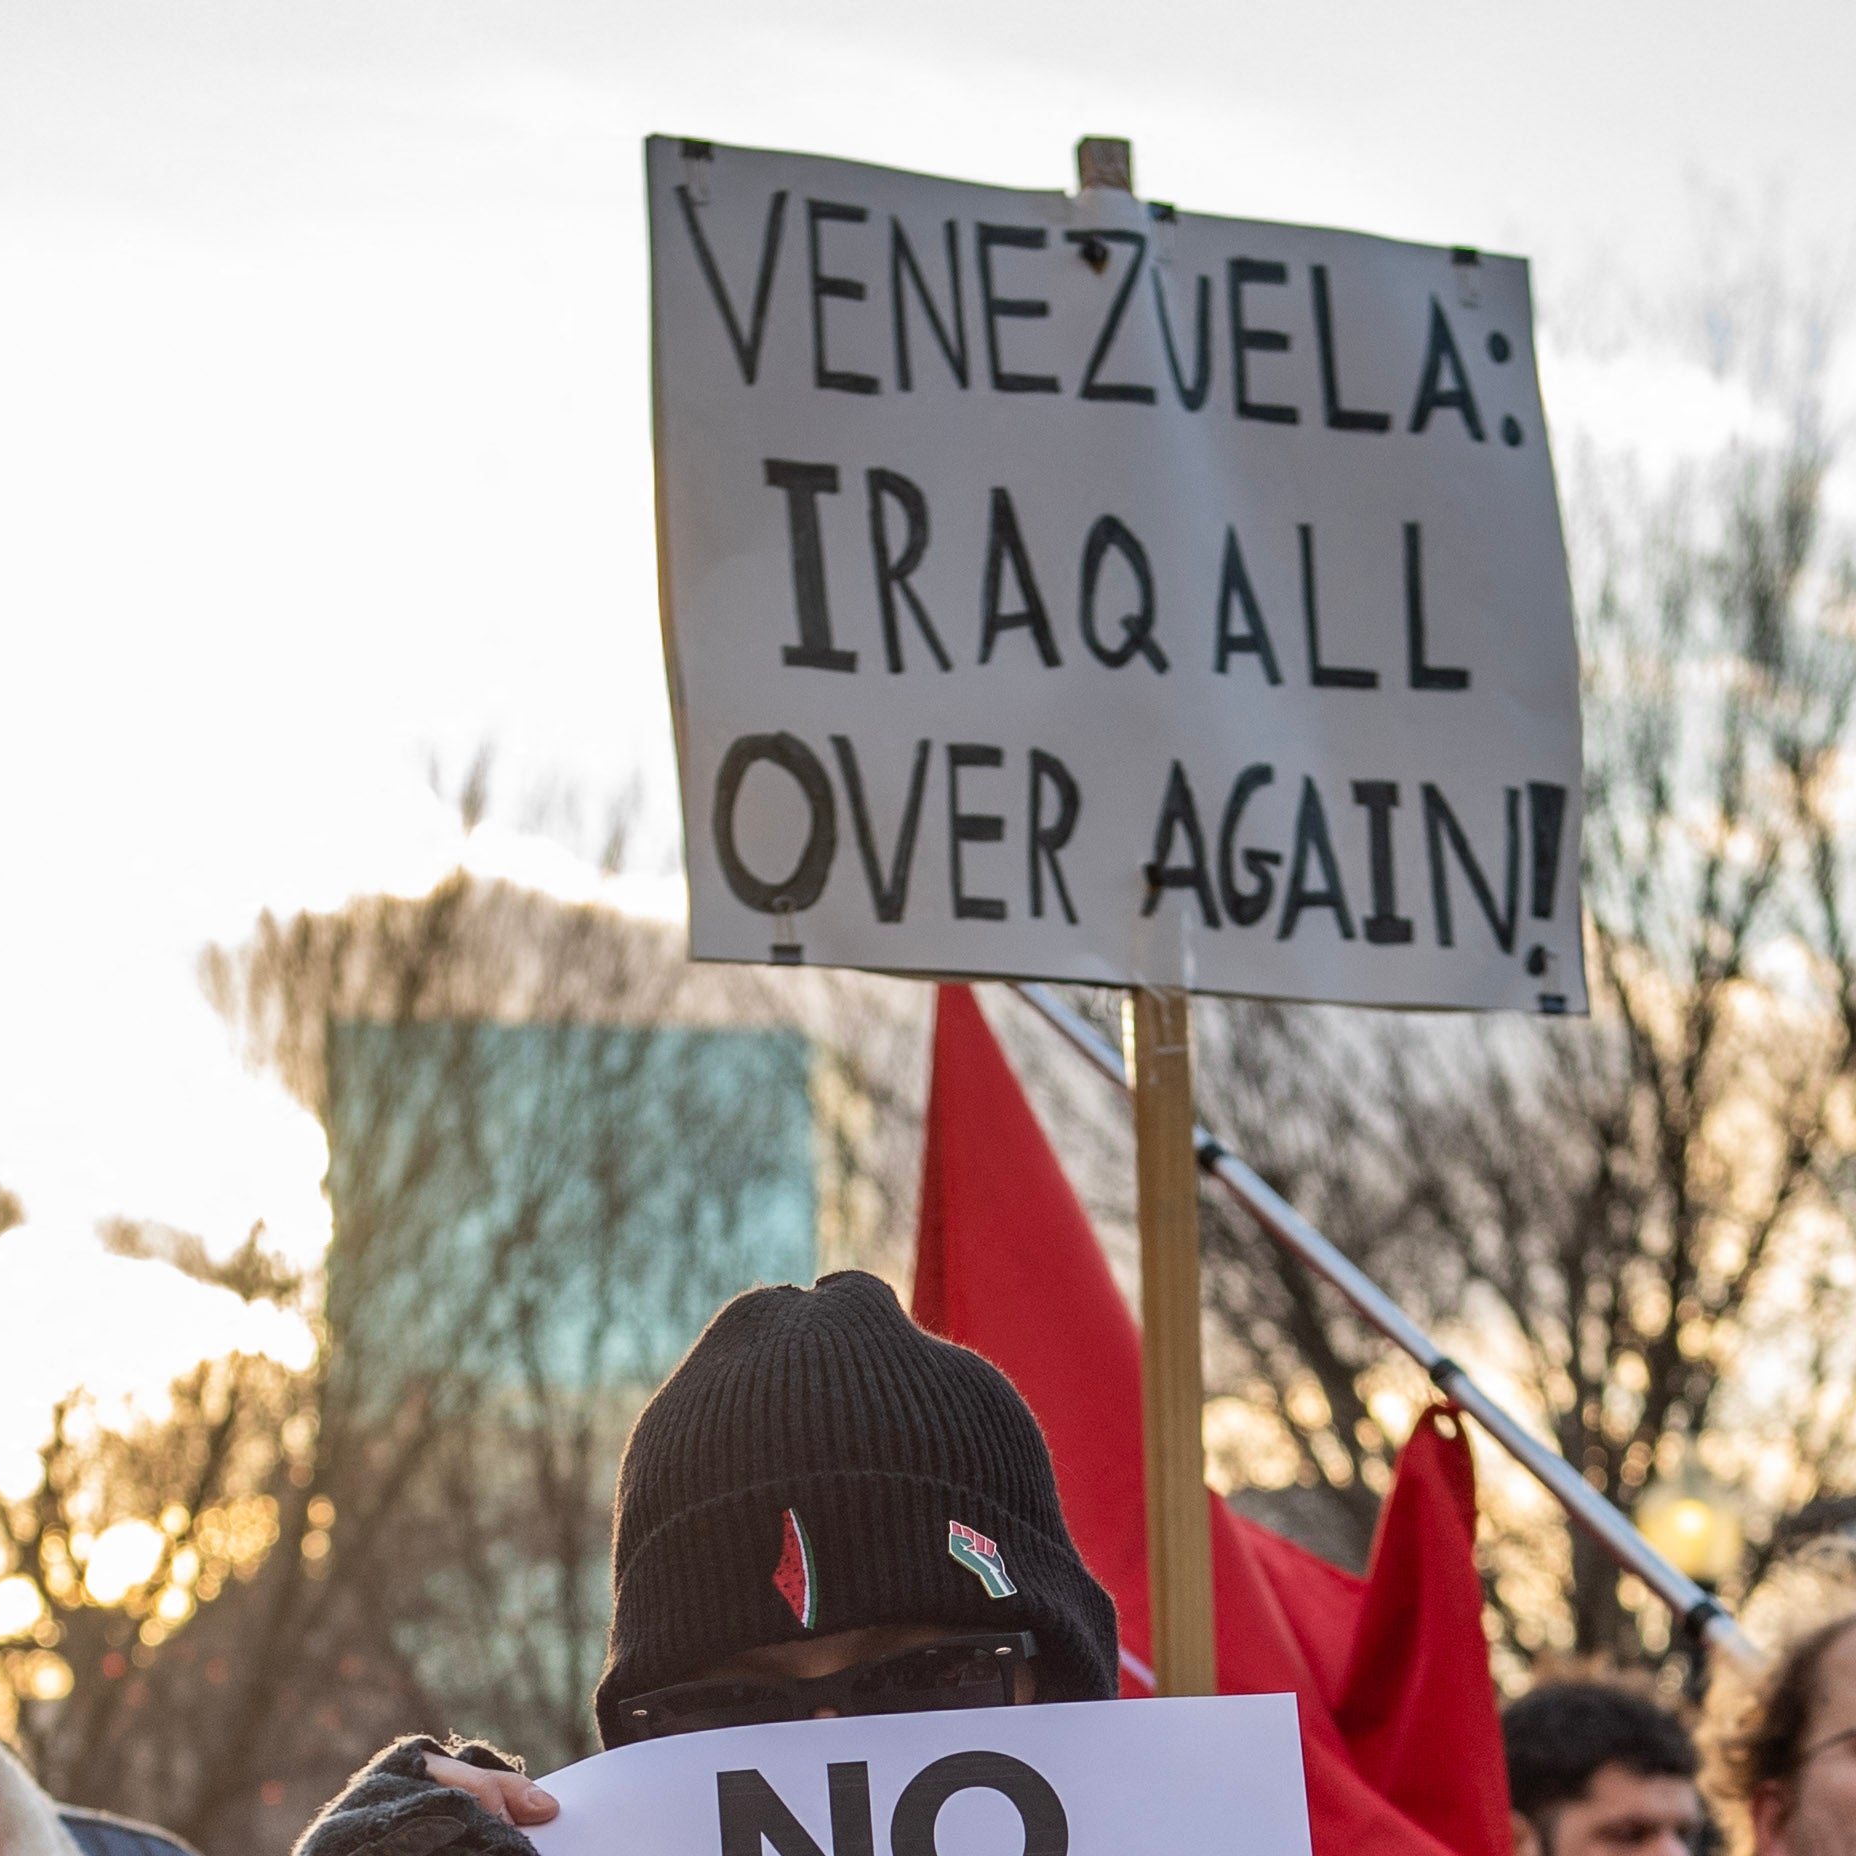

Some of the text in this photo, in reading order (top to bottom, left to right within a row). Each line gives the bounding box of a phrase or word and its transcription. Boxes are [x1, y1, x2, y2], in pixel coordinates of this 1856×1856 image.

[671, 181, 1526, 450] VENEZUELA:
[761, 457, 1474, 693] IRAQ ALL
[711, 730, 1570, 980] OVER AGAIN!
